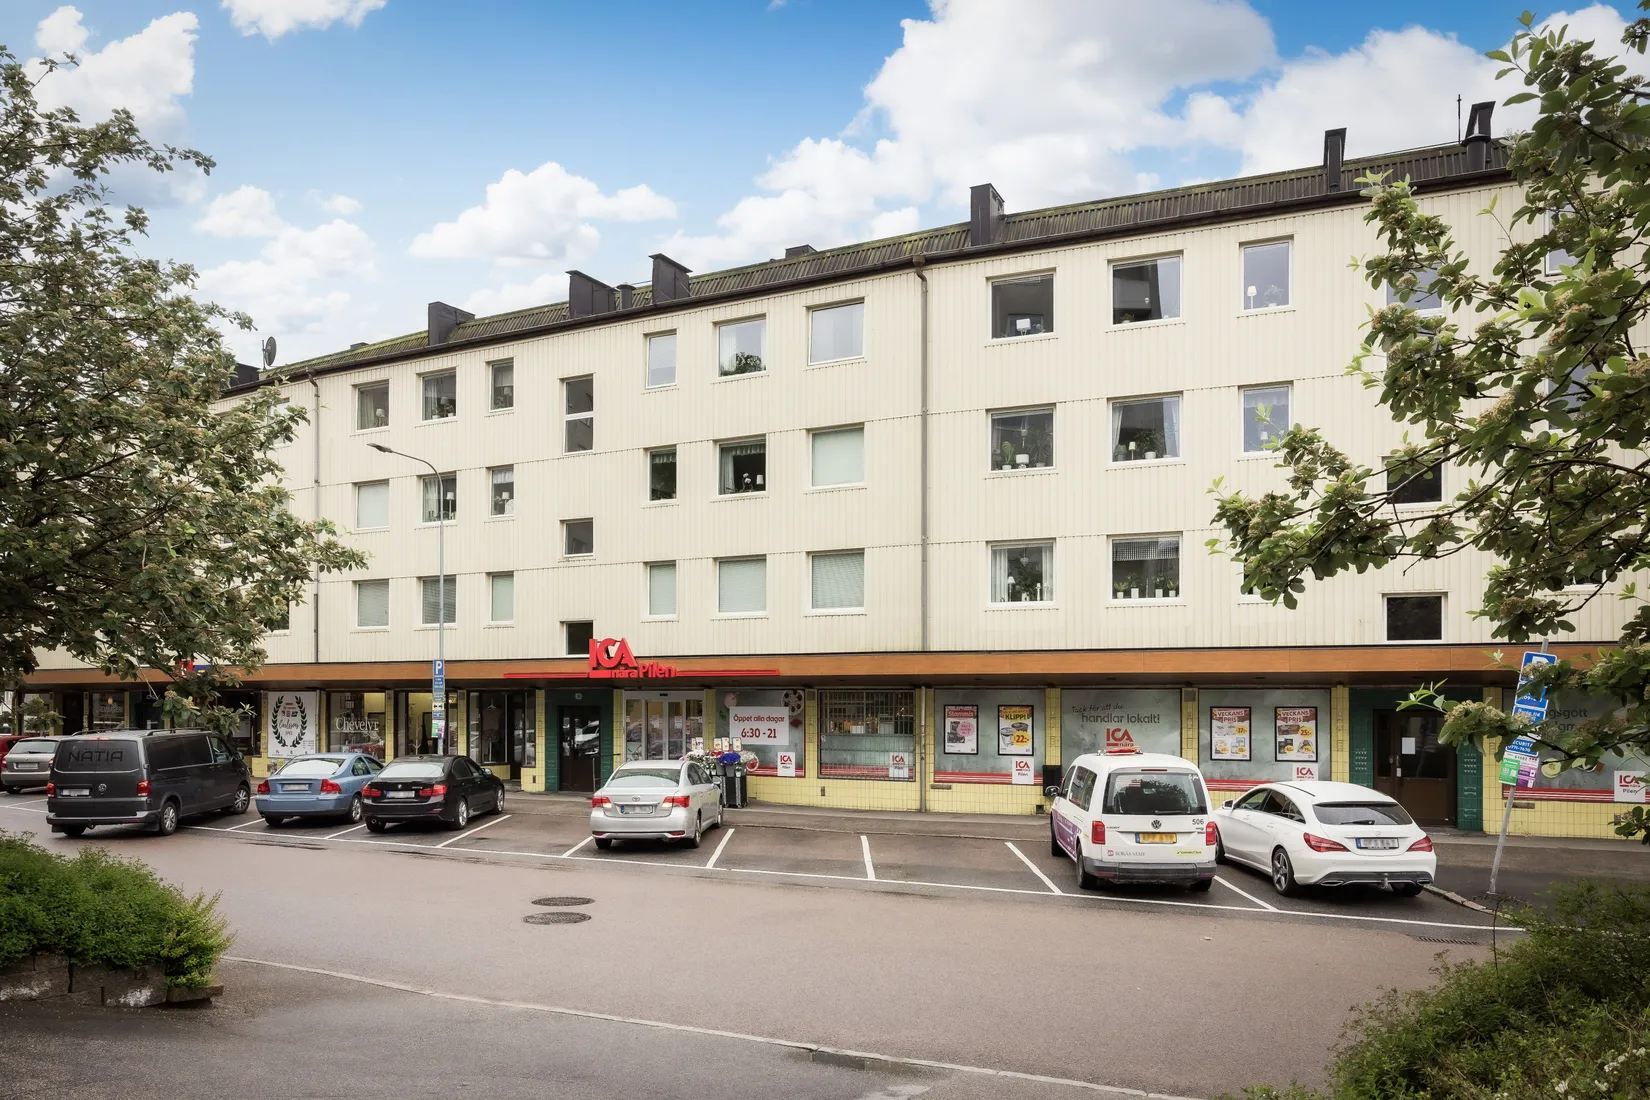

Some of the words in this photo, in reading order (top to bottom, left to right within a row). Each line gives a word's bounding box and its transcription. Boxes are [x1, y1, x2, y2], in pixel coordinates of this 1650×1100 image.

[589, 637, 638, 668] ICA
[435, 661, 442, 674] P
[611, 666, 638, 678] nära
[640, 661, 678, 678] Pilen
[733, 714, 752, 722] Öppet
[1082, 713, 1124, 723] handlar
[1127, 713, 1160, 723] lokalt!
[1546, 708, 1588, 718] gsgott
[741, 728, 760, 738] 6:30
[768, 728, 777, 738] 21
[1106, 728, 1134, 742] ICA
[68, 750, 123, 762] NATIA
[1296, 767, 1314, 776] ICA
[1620, 775, 1640, 784] ICA
